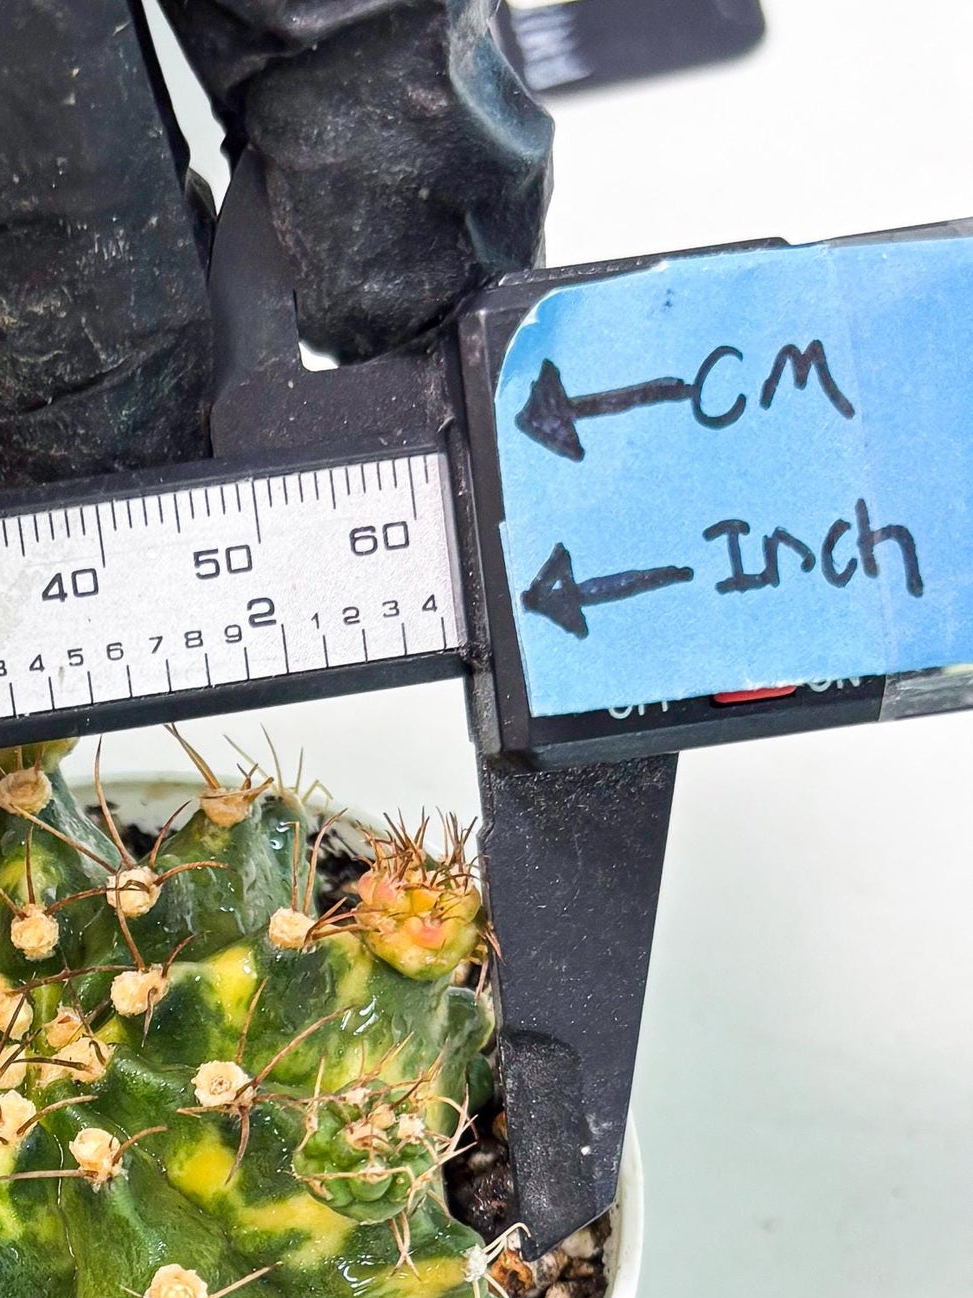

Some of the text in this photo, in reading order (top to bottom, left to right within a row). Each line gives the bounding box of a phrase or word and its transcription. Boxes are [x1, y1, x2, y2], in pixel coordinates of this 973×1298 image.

[41, 568, 99, 602] 40
[193, 544, 253, 580] 50
[349, 521, 410, 556] 60
[703, 498, 924, 598] Inch
[28, 654, 45, 672] 4
[67, 648, 84, 667] 5
[105, 642, 125, 661] 6
[148, 635, 164, 654] 7
[184, 630, 204, 649] 8
[224, 624, 243, 644] 9
[246, 597, 277, 627] 2
[310, 612, 321, 630] 1
[342, 606, 361, 625] 2
[382, 599, 400, 618] 3
[421, 594, 438, 613] 4
